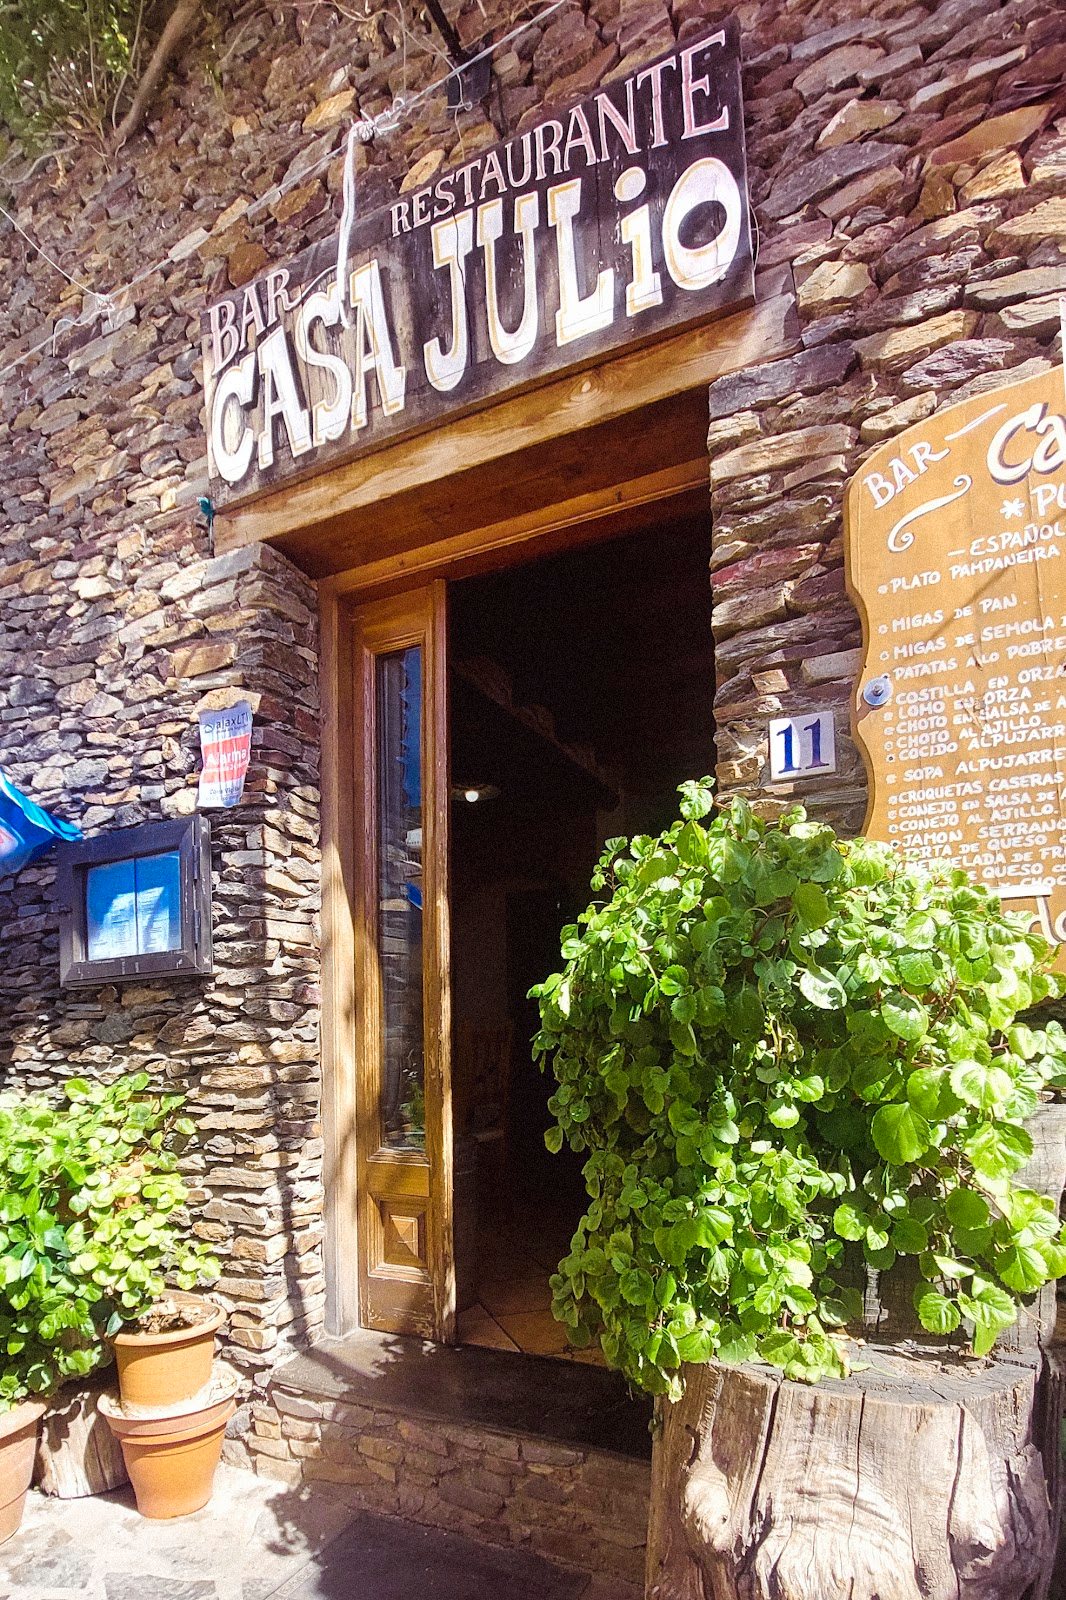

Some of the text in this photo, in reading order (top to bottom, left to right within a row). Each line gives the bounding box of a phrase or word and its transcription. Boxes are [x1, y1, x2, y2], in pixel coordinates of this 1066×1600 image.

[390, 29, 730, 237] RESTAURANTE
[207, 267, 306, 376] BAR
[211, 258, 406, 482] CASA
[863, 440, 950, 509] BAR
[890, 544, 1060, 593] PLATO PAMPANEIRA
[892, 593, 1018, 633] MIGAS DE PAN
[893, 636, 946, 660] MIGAS
[954, 633, 975, 648] DE
[981, 616, 1054, 642] SEMOLA
[893, 657, 958, 681] PATATAS
[895, 665, 1066, 705] COSTILLA EN ORZA
[896, 715, 948, 734] CHOTO
[978, 702, 1030, 721] SALSA
[1032, 700, 1051, 713] DE
[898, 701, 946, 720] LOMO
[984, 686, 1032, 705] ORZA
[776, 717, 830, 774] 11
[896, 730, 950, 748] CHOTO
[959, 727, 978, 739] AL
[898, 742, 958, 761] COCIDO
[898, 771, 1064, 803] CROQUETAS CASERAS
[903, 766, 944, 782] SOPA
[898, 801, 957, 817] CONEJO
[961, 800, 980, 811] EN
[983, 792, 1032, 809] SALSA
[1035, 790, 1057, 803] DE
[899, 813, 959, 832] CONEJO
[966, 814, 985, 825] AL
[901, 829, 963, 848] JAMON
[977, 819, 1066, 839] SERRANO
[958, 842, 980, 854] DE
[986, 833, 1048, 851] QUESO
[1011, 852, 1033, 862] DE
[982, 863, 1043, 879] QUESO
